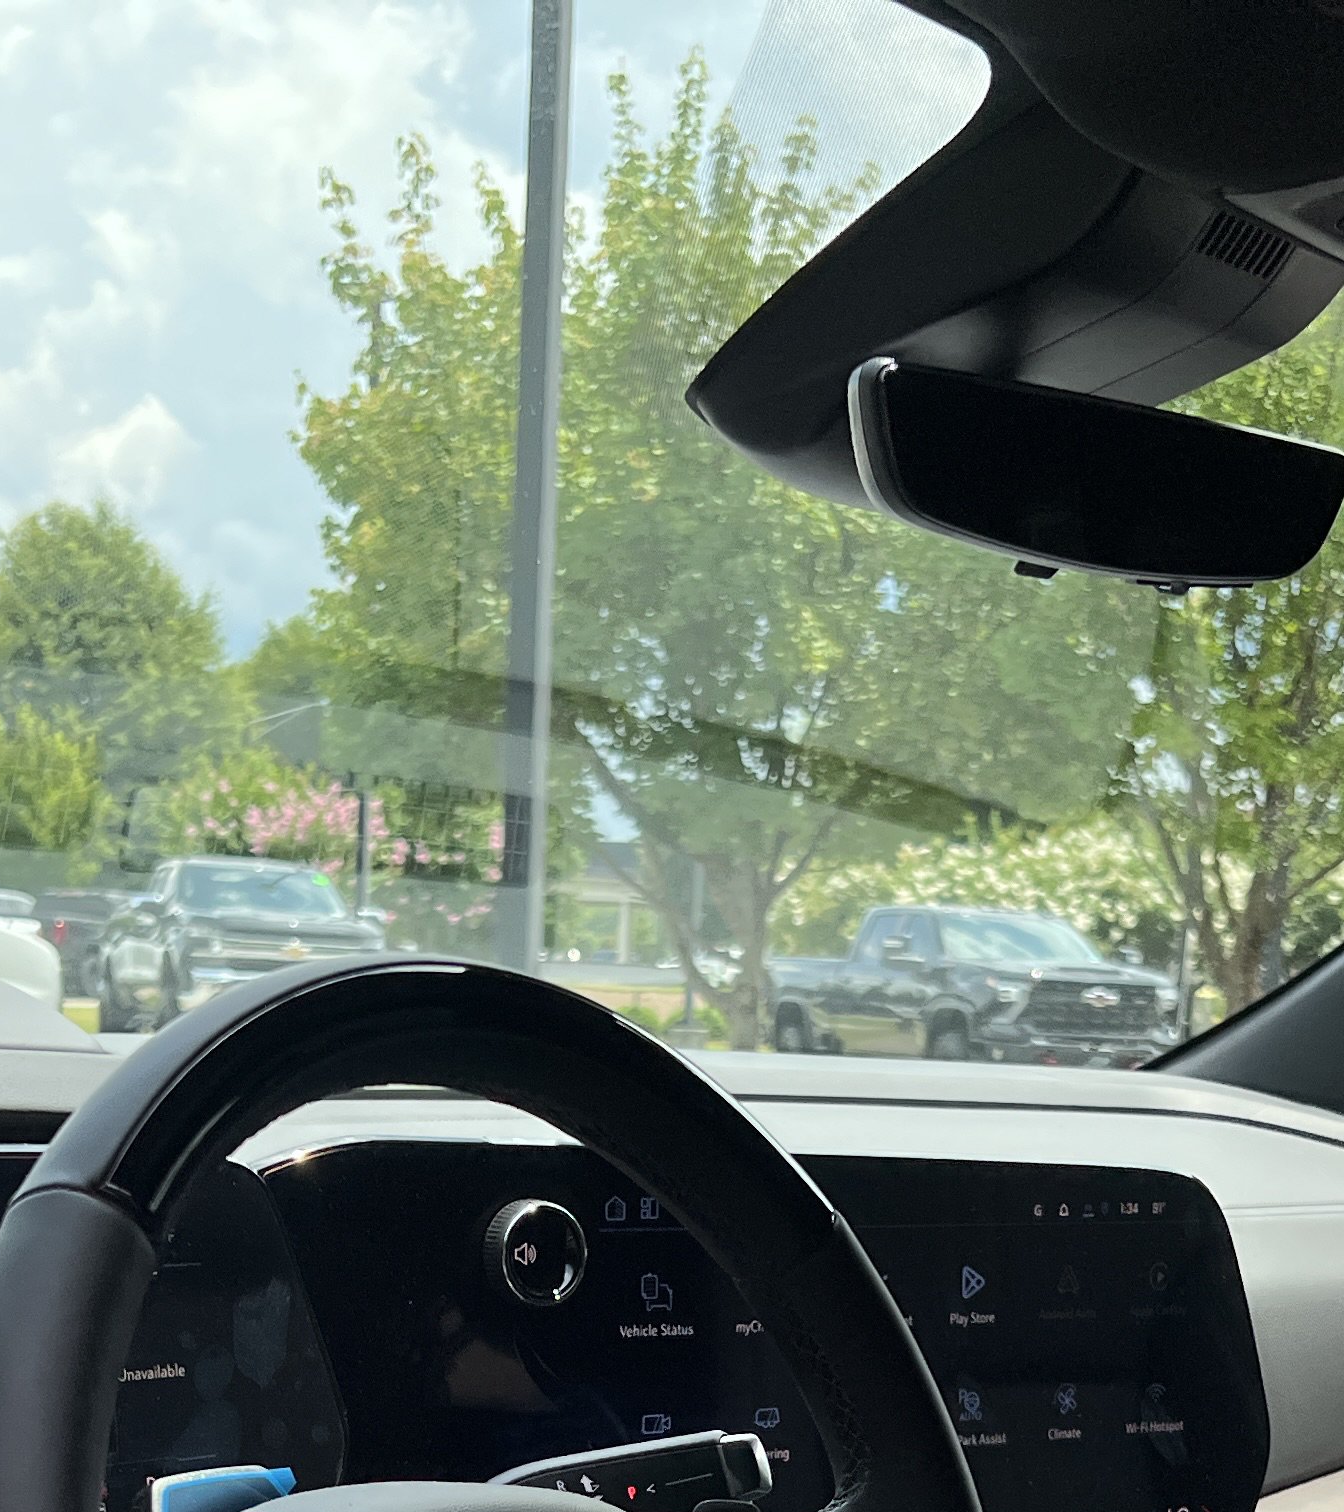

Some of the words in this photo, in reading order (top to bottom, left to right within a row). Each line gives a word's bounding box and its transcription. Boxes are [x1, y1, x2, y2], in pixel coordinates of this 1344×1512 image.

[949, 1312, 969, 1327] Play
[970, 1311, 995, 1324] Store
[619, 1323, 658, 1338] Vehicle
[660, 1323, 694, 1337] Status
[978, 1432, 1007, 1445] Assist
[1047, 1428, 1082, 1441] Climate
